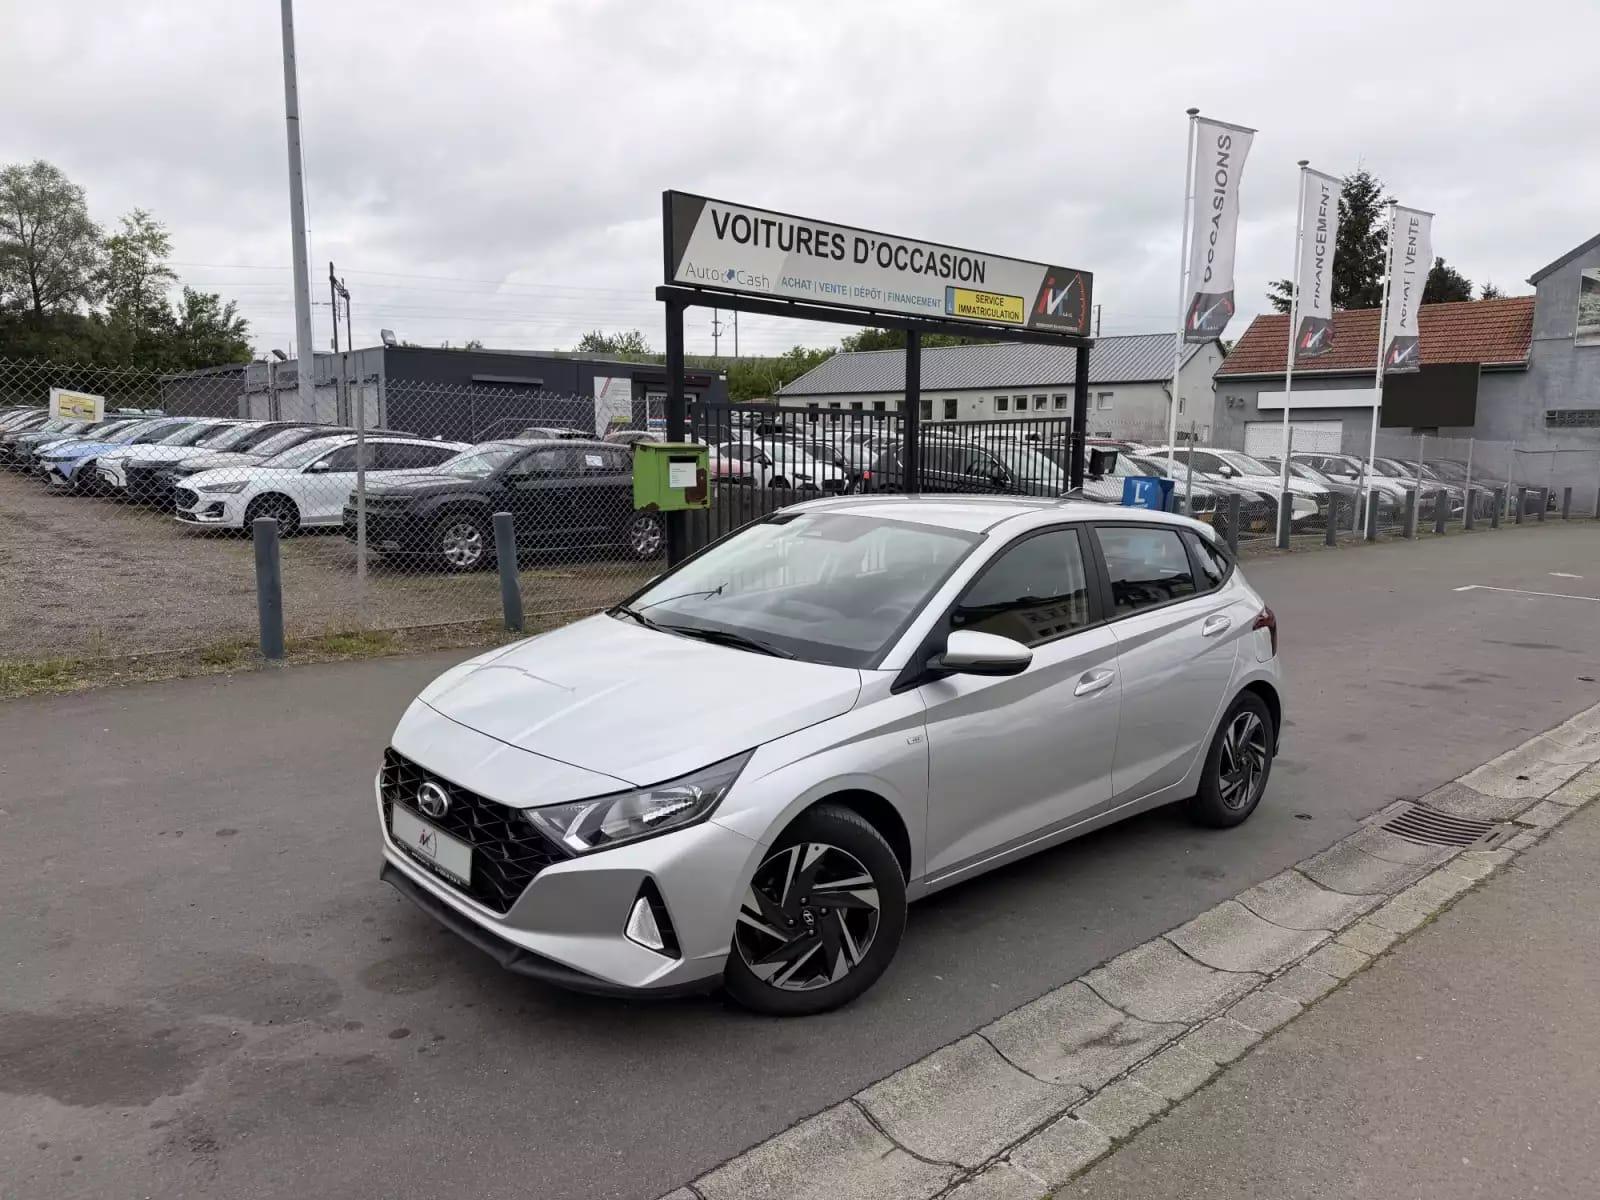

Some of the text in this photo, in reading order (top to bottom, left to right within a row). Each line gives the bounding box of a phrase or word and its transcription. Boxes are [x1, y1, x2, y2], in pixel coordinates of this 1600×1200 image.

[1203, 133, 1232, 283] OCCASIONS
[711, 208, 986, 284] VOITURES D'OCCASION
[1313, 183, 1330, 309] FINANCEMENT
[1400, 216, 1420, 328] ACHAT VENTE
[736, 270, 771, 289] Cash
[781, 276, 943, 308] ACHAT VENTE DÉPÔT FINANCEMENT
[975, 294, 1005, 307] SERVICE
[958, 302, 1020, 321] IMMATRICULATION
